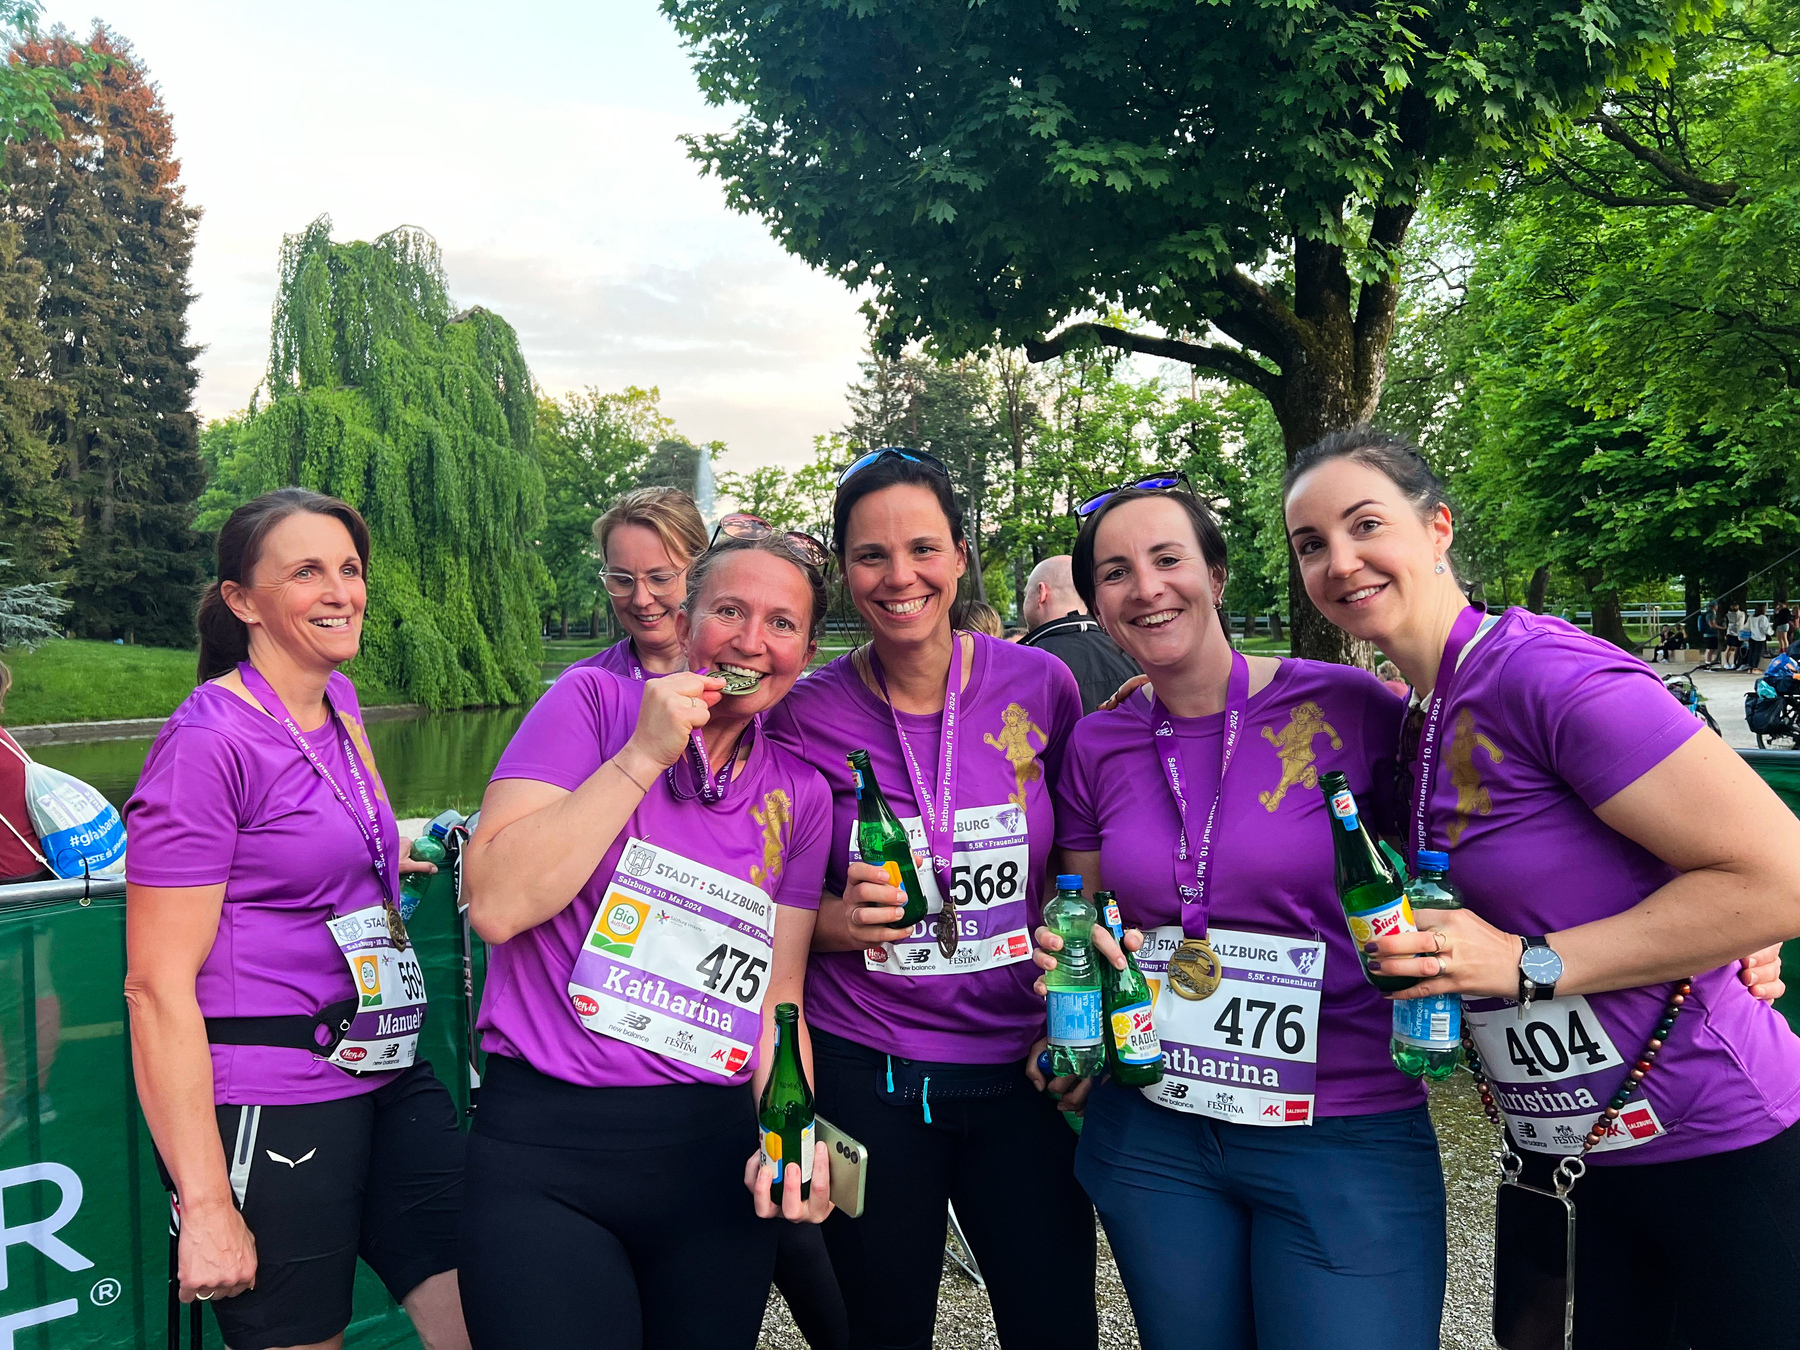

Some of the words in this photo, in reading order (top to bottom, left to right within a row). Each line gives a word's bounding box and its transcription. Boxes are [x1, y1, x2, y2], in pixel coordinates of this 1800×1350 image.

[1431, 697, 1442, 721] 2024
[284, 718, 299, 736] 2024
[947, 712, 955, 727] Mai
[1230, 710, 1239, 730] 2024
[946, 728, 954, 739] 10.
[1227, 732, 1236, 747] Mai
[1426, 724, 1436, 742] Mai
[297, 736, 309, 750] Mai
[1424, 746, 1433, 759] 10.
[943, 742, 953, 785] Frauenlauf
[343, 739, 361, 779] Salzburger
[357, 780, 376, 822] Frauenlauf
[1417, 762, 1430, 818] Frauenlauf
[940, 790, 951, 833] Salzburger
[969, 841, 984, 850] 5,5K
[989, 836, 1025, 848] Frauenlauf
[1417, 821, 1427, 851] burger
[1199, 845, 1209, 860] 10.
[1197, 861, 1206, 879] Mai
[655, 863, 699, 888] STADT
[706, 883, 766, 917] SALZBURG
[951, 861, 1018, 905] 568
[617, 875, 651, 895] Salzburg
[657, 889, 667, 900] 10.
[668, 892, 684, 906] Mai
[683, 899, 702, 914] 2024
[613, 907, 634, 924] Bio
[1371, 910, 1400, 936] Stiegl
[610, 919, 631, 931] AUSTRIA
[910, 915, 978, 939] Dois
[993, 945, 1007, 957] AK
[1209, 943, 1278, 962] ALZBURG
[911, 964, 936, 972] balance
[949, 955, 981, 966] FESTINA
[362, 967, 374, 978] Bio
[398, 962, 424, 1000] 569
[463, 956, 472, 997] LEKI
[696, 943, 768, 1004] 475
[1247, 972, 1265, 981] 5,5K
[1271, 975, 1317, 988] Frauenlauf
[573, 996, 598, 1013] Hervis
[602, 965, 733, 1033] Katharina
[375, 1008, 423, 1036] Manuel
[1213, 996, 1306, 1055] 476
[608, 1024, 622, 1034] new
[622, 1028, 650, 1043] balance
[1131, 1030, 1158, 1047] RADLE
[664, 1036, 697, 1054] FESTINA
[1505, 1009, 1608, 1077] 404
[710, 1049, 726, 1063] AK
[1163, 1048, 1280, 1088] atharina
[1169, 1098, 1194, 1109] balance
[1207, 1101, 1244, 1114] FESTINA
[1500, 1087, 1599, 1113] hristina
[1262, 1105, 1281, 1117] AK
[1606, 1123, 1625, 1138] AK
[1627, 1119, 1653, 1130] SALZBURG
